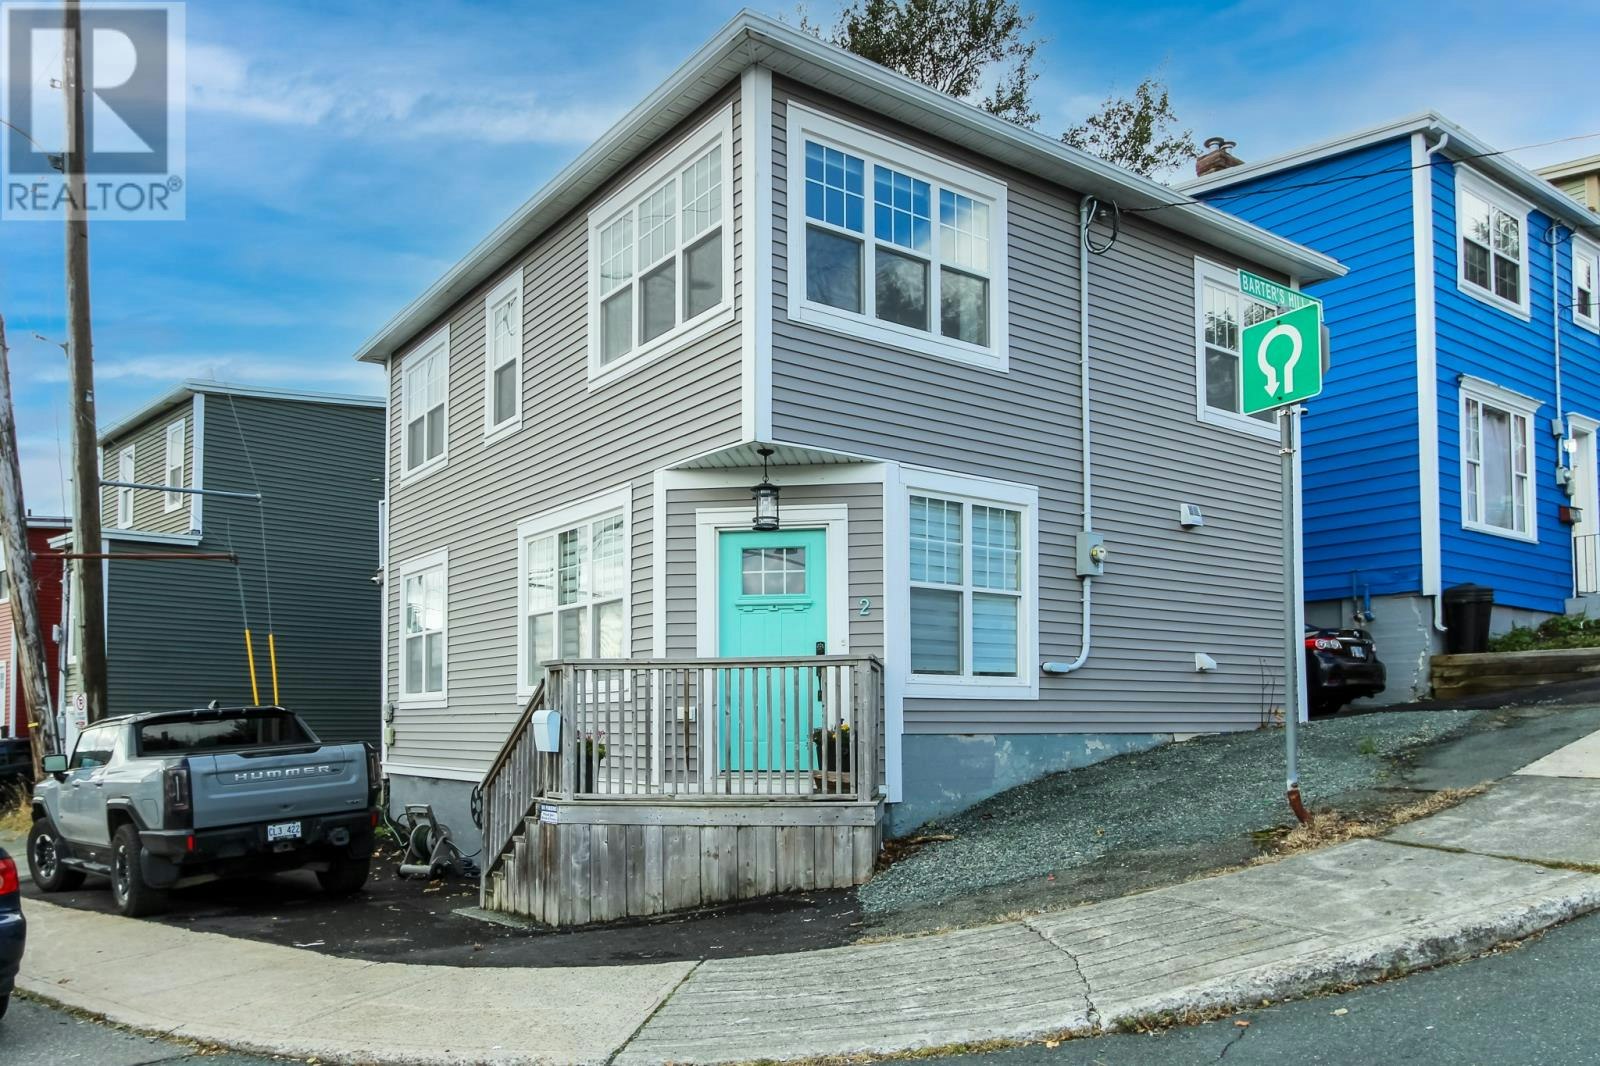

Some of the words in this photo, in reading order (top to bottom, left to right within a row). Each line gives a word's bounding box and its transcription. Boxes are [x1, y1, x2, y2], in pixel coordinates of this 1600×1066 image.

[1242, 274, 1285, 304] BARTER'S
[859, 598, 870, 616] 2
[234, 765, 330, 781] HUMMER
